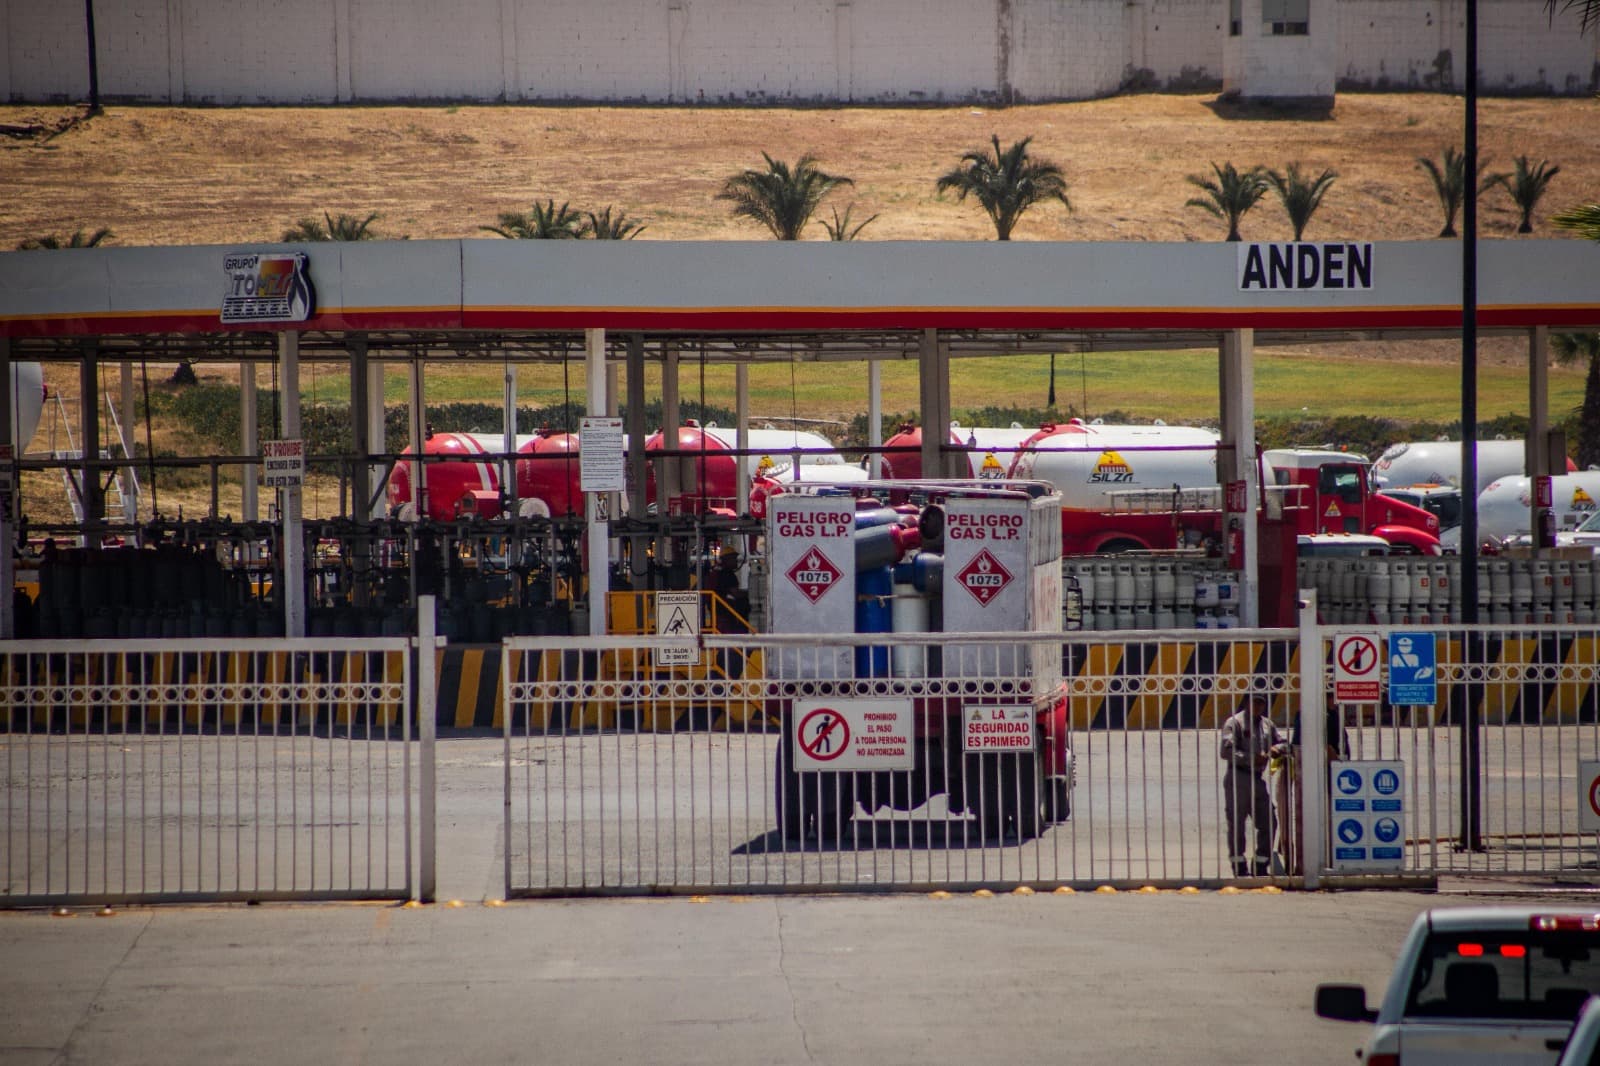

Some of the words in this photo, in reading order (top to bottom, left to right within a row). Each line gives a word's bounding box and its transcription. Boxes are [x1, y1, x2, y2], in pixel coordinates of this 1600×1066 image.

[225, 258, 255, 270] GRUPO
[1241, 243, 1372, 289] ANDEN
[776, 511, 853, 525] PELIGRO
[947, 514, 1024, 528] PELIGRO
[779, 524, 816, 538] GAS
[820, 525, 849, 538] L.P.
[949, 527, 986, 540] GAS
[991, 528, 1020, 540] L.P.
[798, 572, 831, 583] 1075
[968, 575, 1001, 586] 1075
[809, 585, 819, 596] 2
[980, 588, 990, 599] 2
[863, 713, 897, 721] PROHIBIDO
[991, 709, 1006, 720] LA
[867, 725, 875, 733] EL
[876, 725, 892, 733] PASO
[968, 722, 1030, 733] SEGURIDAD
[855, 736, 861, 745] A
[861, 736, 877, 745] TODA
[878, 736, 907, 745] PERSONA
[967, 736, 981, 747] ES
[983, 735, 1031, 747] PRIMERO
[856, 749, 866, 757] NO
[867, 748, 905, 757] AUTORIZADA
